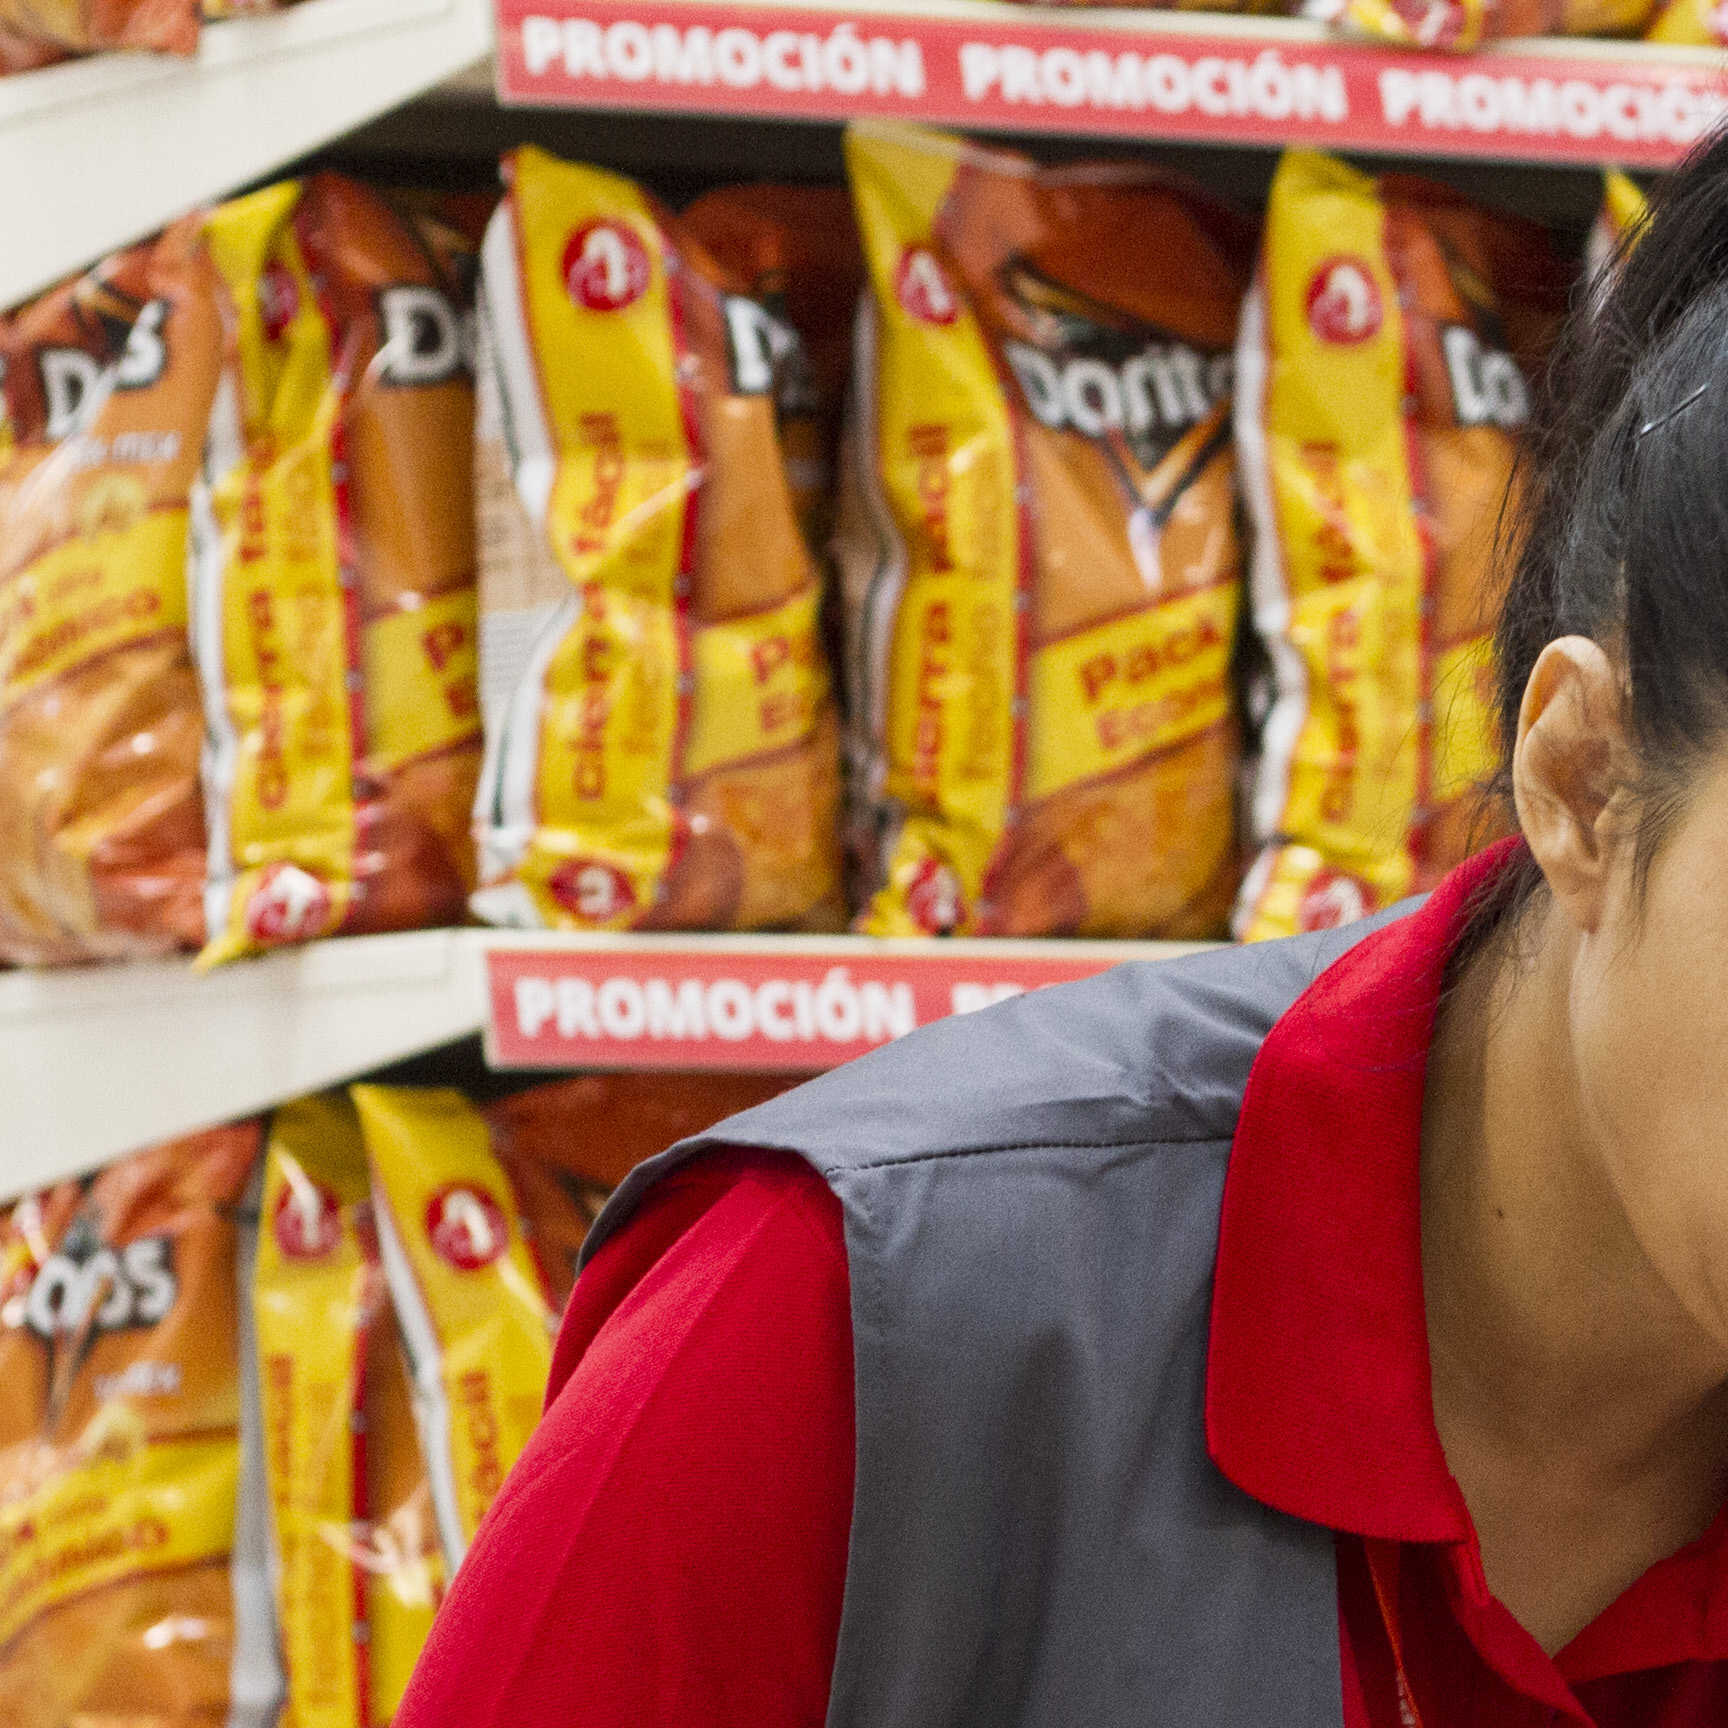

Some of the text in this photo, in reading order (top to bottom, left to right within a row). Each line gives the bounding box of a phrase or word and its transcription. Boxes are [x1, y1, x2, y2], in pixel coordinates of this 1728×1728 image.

[522, 15, 924, 97] PROMOCIÓN
[960, 43, 1347, 121] PROMOCIÓN
[514, 966, 915, 1042] PROMOCIÓN
